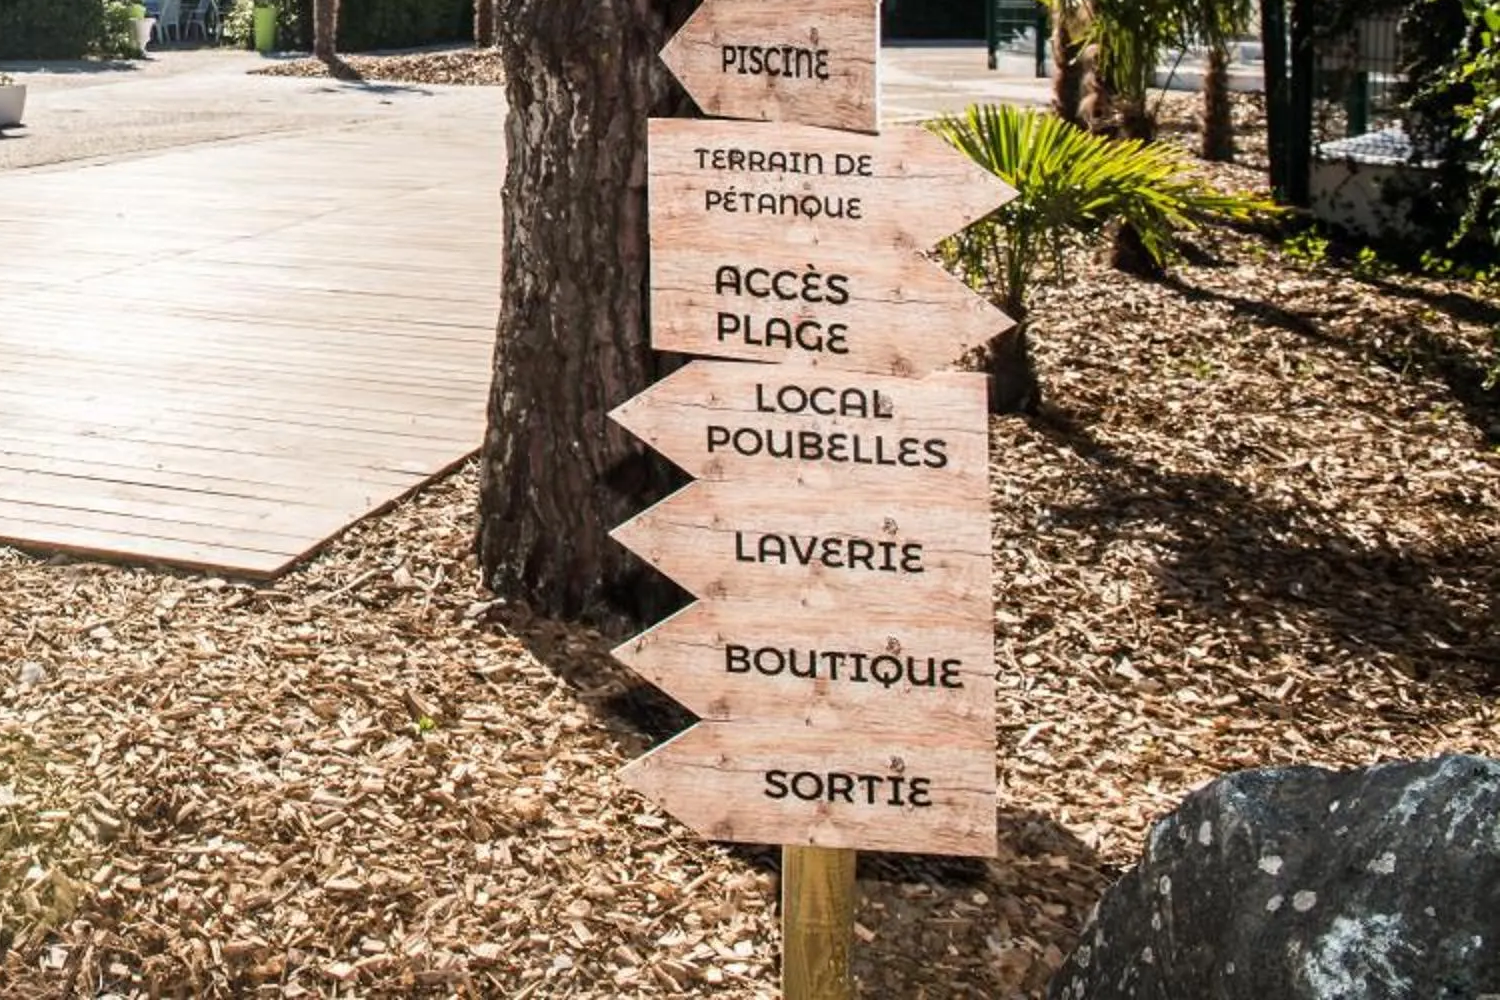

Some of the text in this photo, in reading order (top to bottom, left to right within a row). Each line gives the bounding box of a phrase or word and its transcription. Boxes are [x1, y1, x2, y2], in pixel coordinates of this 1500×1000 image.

[721, 44, 831, 82] PISCINE
[693, 147, 874, 177] TERRAIN DE
[704, 186, 863, 221] PÉTANQUE
[714, 263, 850, 305] ACCÈS
[716, 312, 850, 355] PLAGE
[755, 382, 894, 419] LOCAL
[706, 425, 949, 469] POUBELLES
[735, 530, 925, 574] LAVERIE
[724, 643, 965, 690] BOUTIQUE
[763, 768, 933, 808] SORTIE
